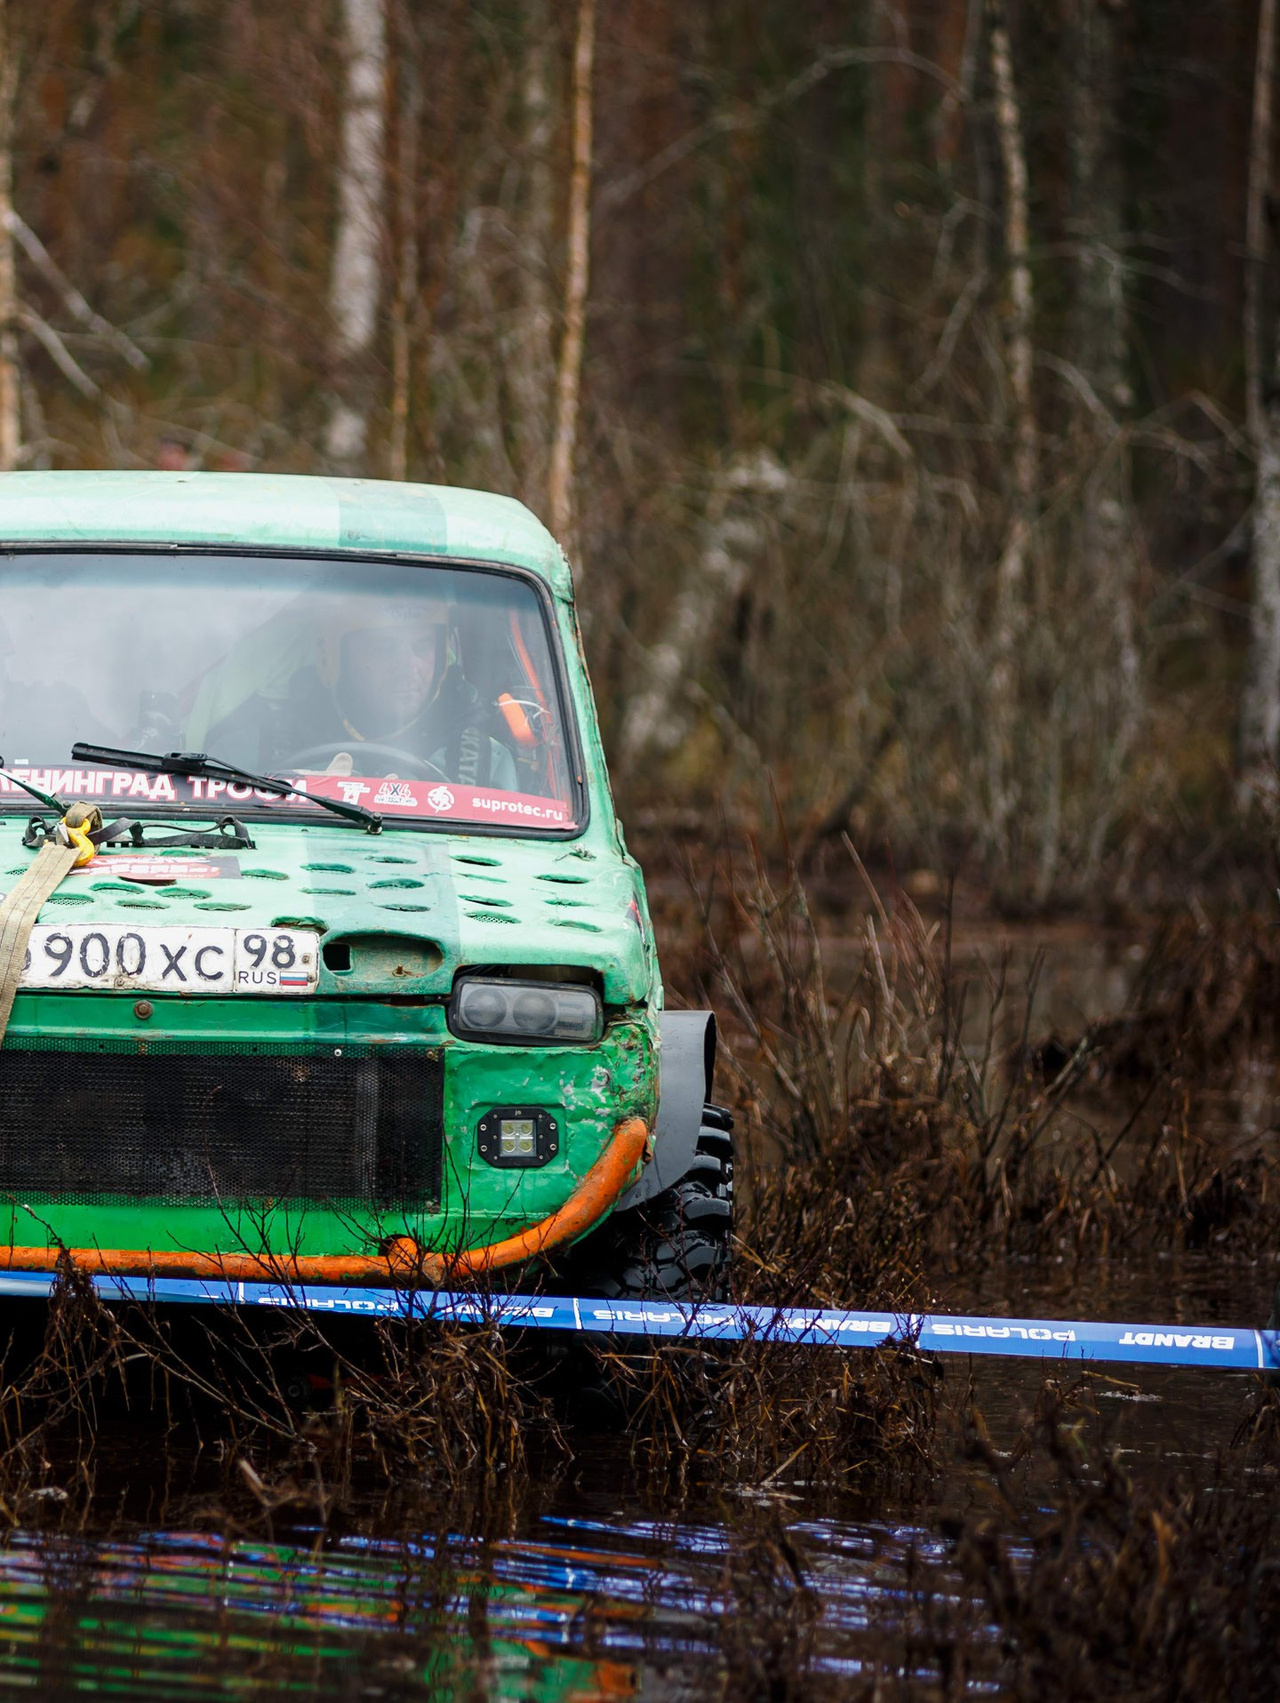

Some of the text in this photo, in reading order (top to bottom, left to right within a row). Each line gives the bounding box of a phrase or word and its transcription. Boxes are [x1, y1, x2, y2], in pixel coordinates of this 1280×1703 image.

[472, 797, 563, 821] suprotec.ru
[243, 934, 296, 969] 98
[238, 971, 277, 985] RUS
[931, 1323, 1235, 1350] BRANDT POLARIS
